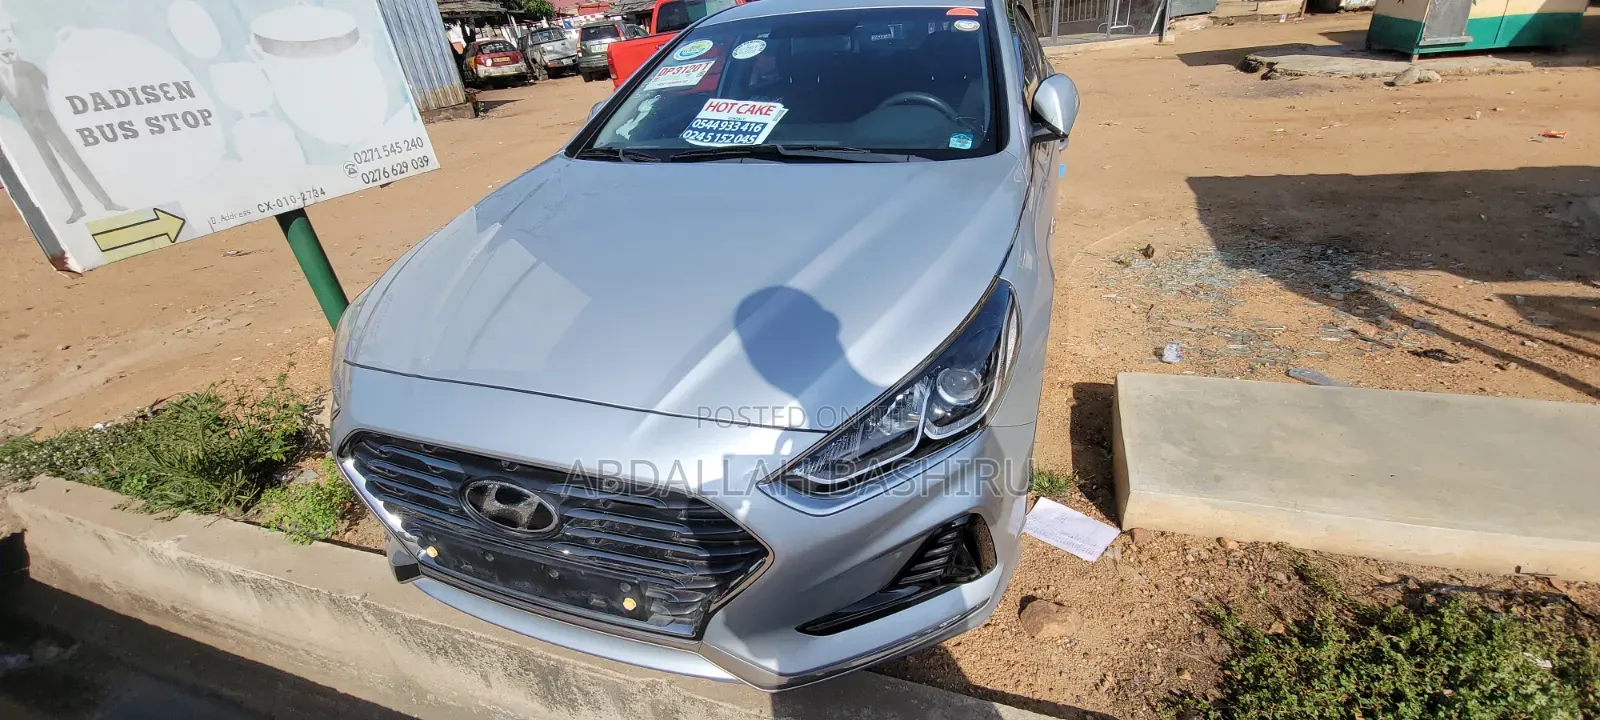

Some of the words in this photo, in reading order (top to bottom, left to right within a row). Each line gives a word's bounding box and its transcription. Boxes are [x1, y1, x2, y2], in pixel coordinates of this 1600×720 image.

[704, 101, 739, 114] HOT
[736, 103, 776, 117] CAKE
[76, 120, 140, 147] BUS
[145, 108, 213, 136] STOP
[691, 119, 719, 130] 0544
[718, 120, 742, 131] 933
[740, 122, 764, 133] 416
[712, 133, 734, 144] 152
[735, 134, 757, 144] 045
[353, 147, 382, 165] 0271
[382, 141, 403, 158] 545
[403, 136, 424, 151] 240
[361, 166, 390, 184] 0276
[391, 161, 409, 176] 629
[411, 155, 430, 170] 039
